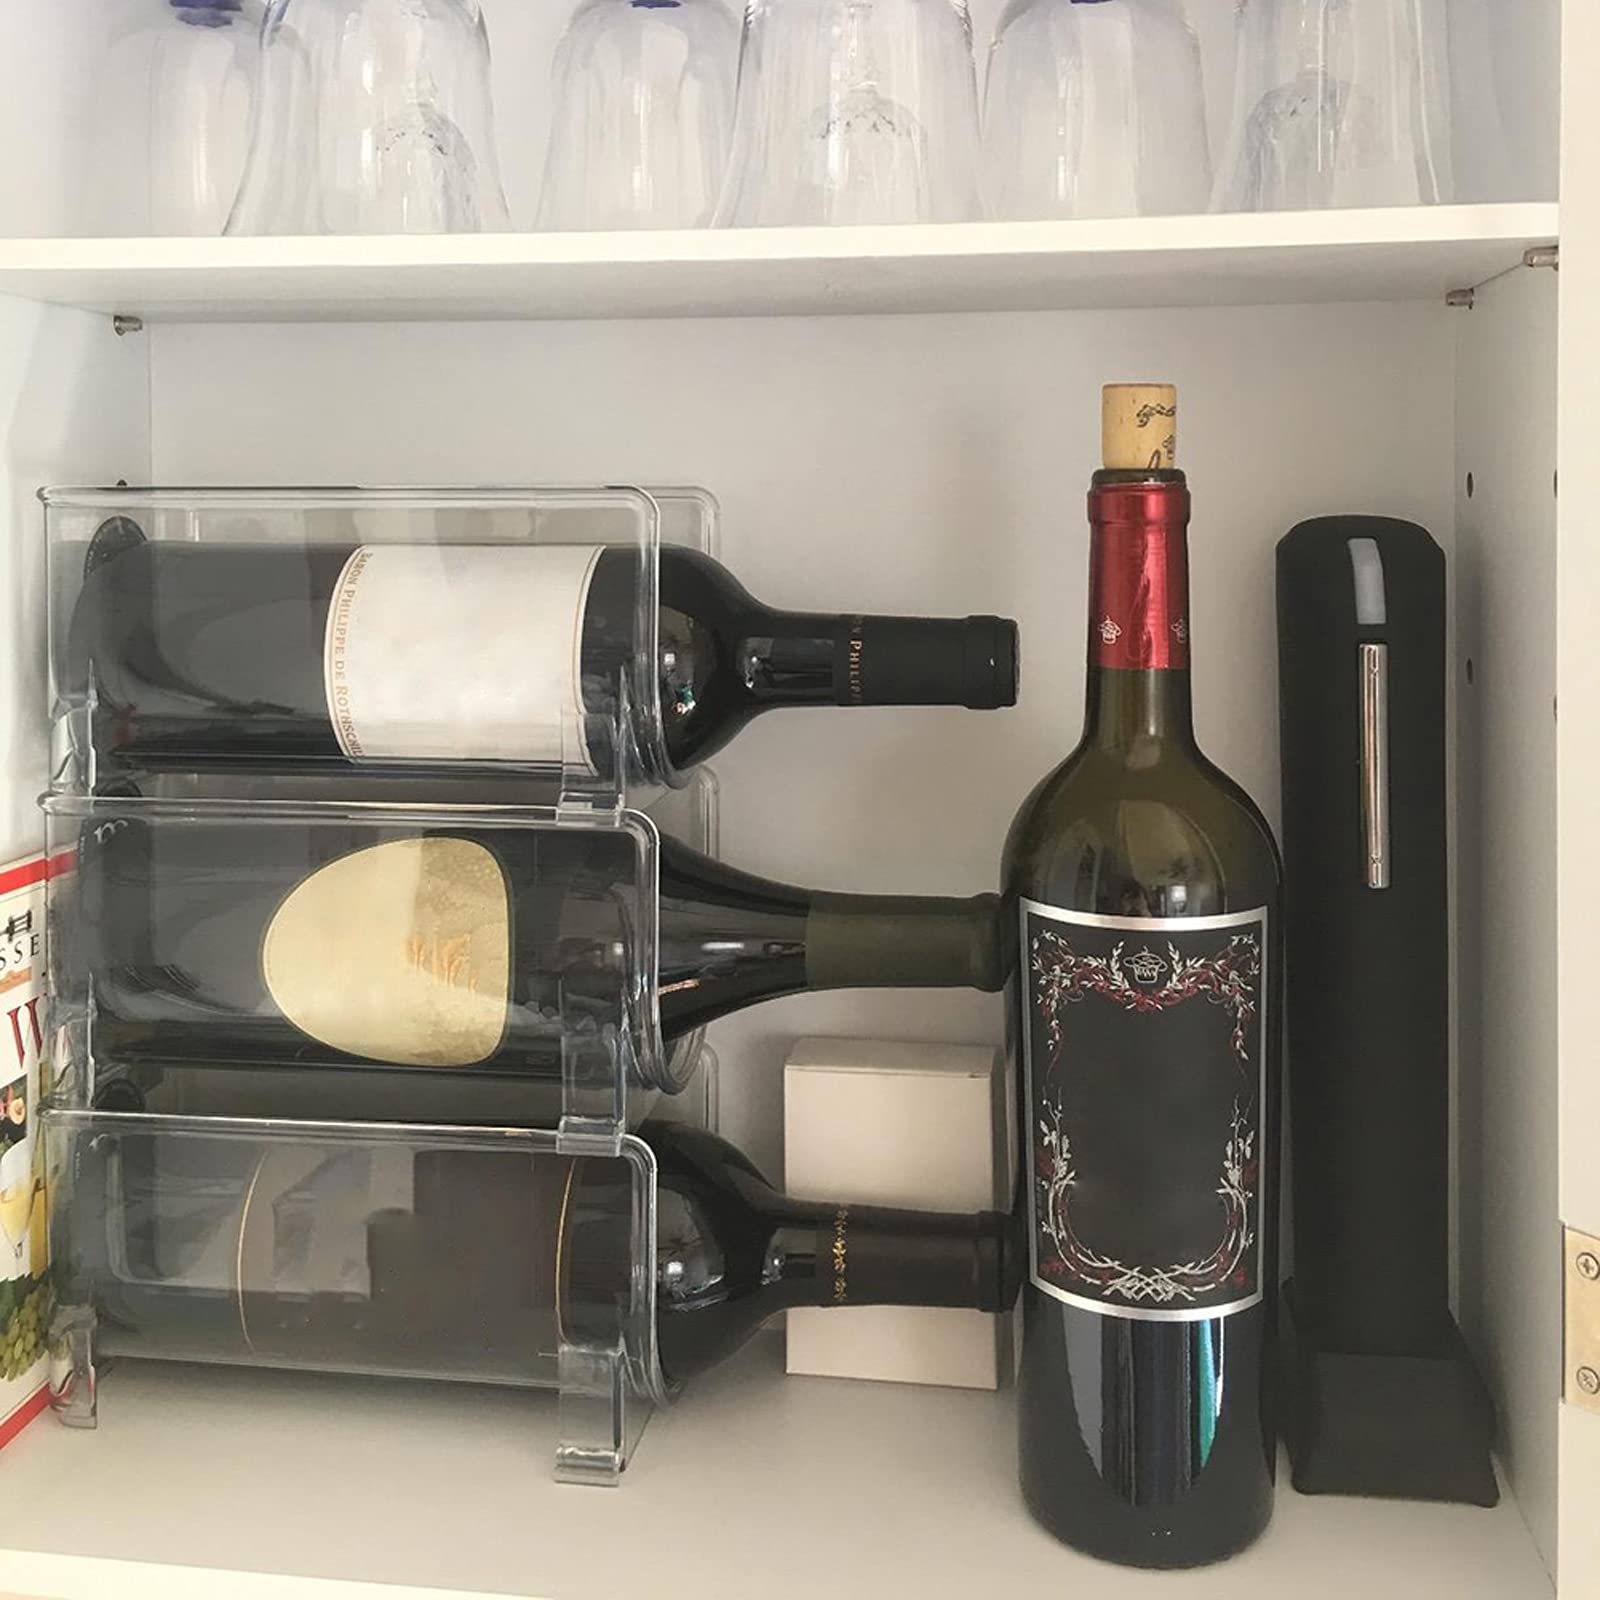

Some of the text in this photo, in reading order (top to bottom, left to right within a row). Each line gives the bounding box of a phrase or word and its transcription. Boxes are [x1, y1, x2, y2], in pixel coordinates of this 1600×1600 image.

[335, 590, 356, 654] PHILIPPE
[335, 660, 345, 679] DE
[335, 686, 365, 758] ROTHSCHIL
